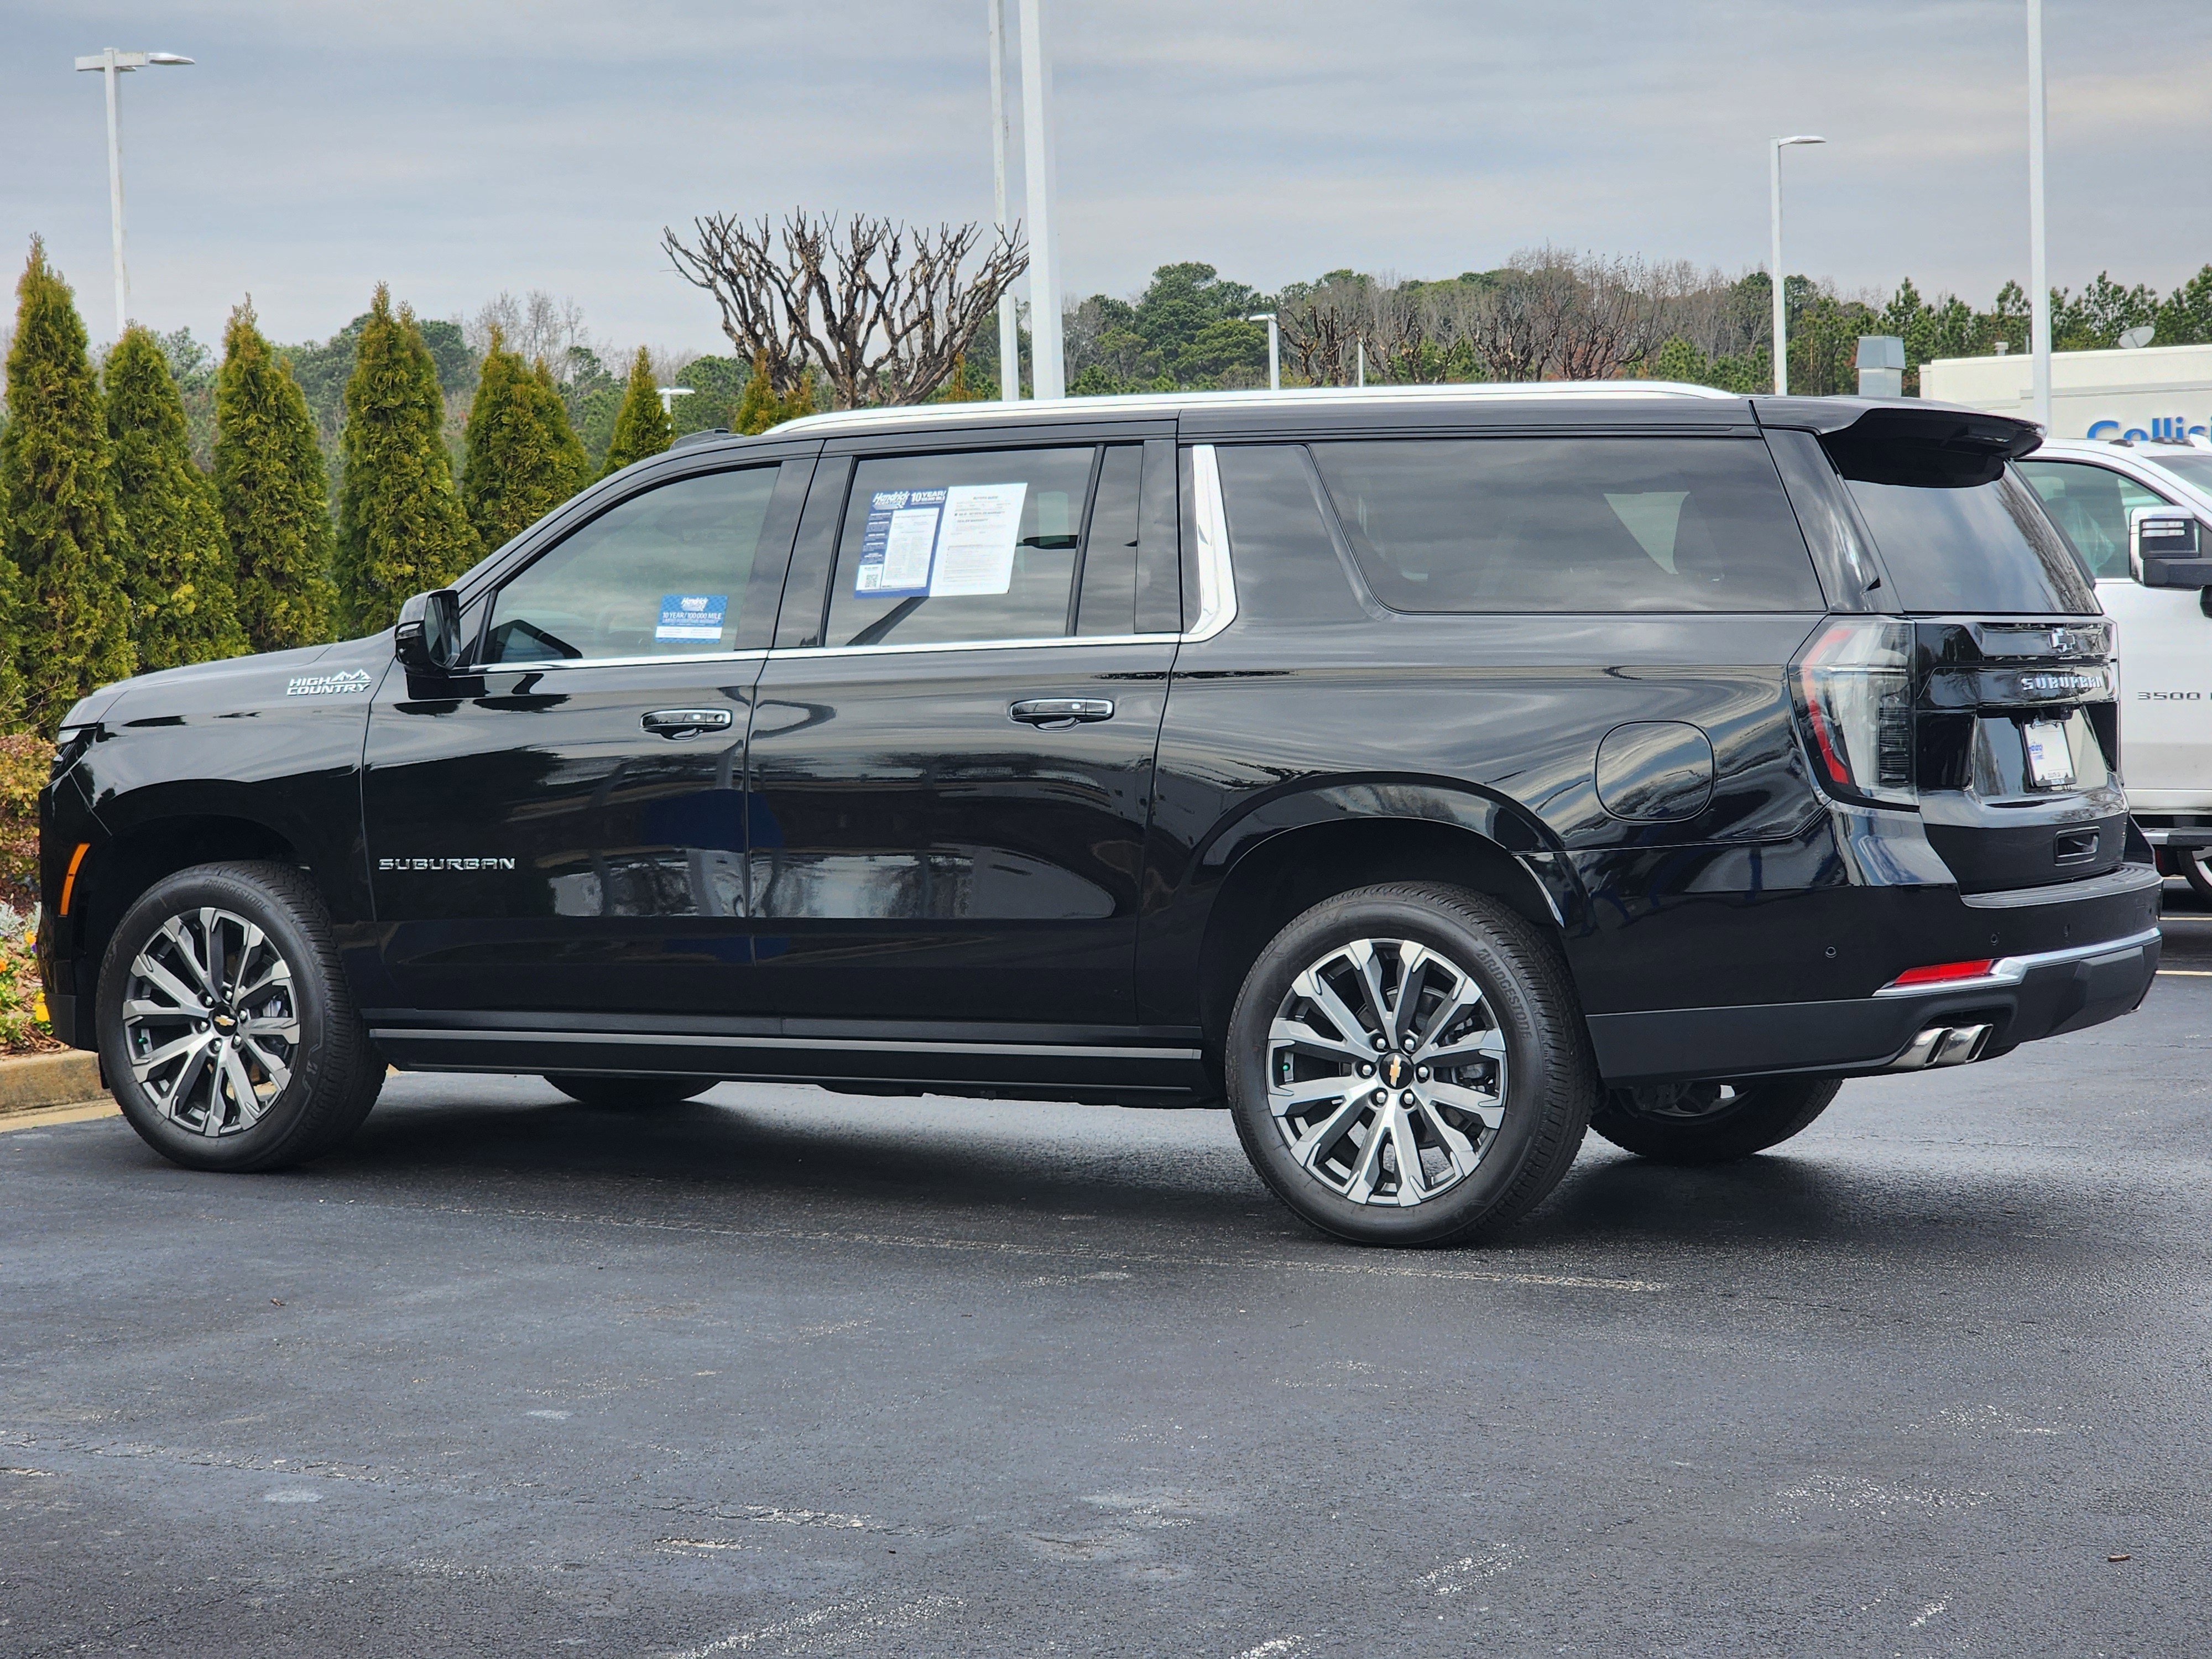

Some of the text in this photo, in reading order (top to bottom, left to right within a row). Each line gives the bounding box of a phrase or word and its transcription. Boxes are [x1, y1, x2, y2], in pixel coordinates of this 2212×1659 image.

[2087, 416, 2212, 444] Colli
[872, 491, 910, 503] Hendrick
[911, 492, 922, 503] 10
[289, 677, 331, 687] HIGH
[2021, 676, 2103, 691] SUBURBAN
[286, 682, 371, 696] COUNTRY
[2137, 691, 2201, 701] 3500
[378, 858, 516, 871] SUBURBAN
[1477, 948, 1533, 1040] BRIDGESTONE
